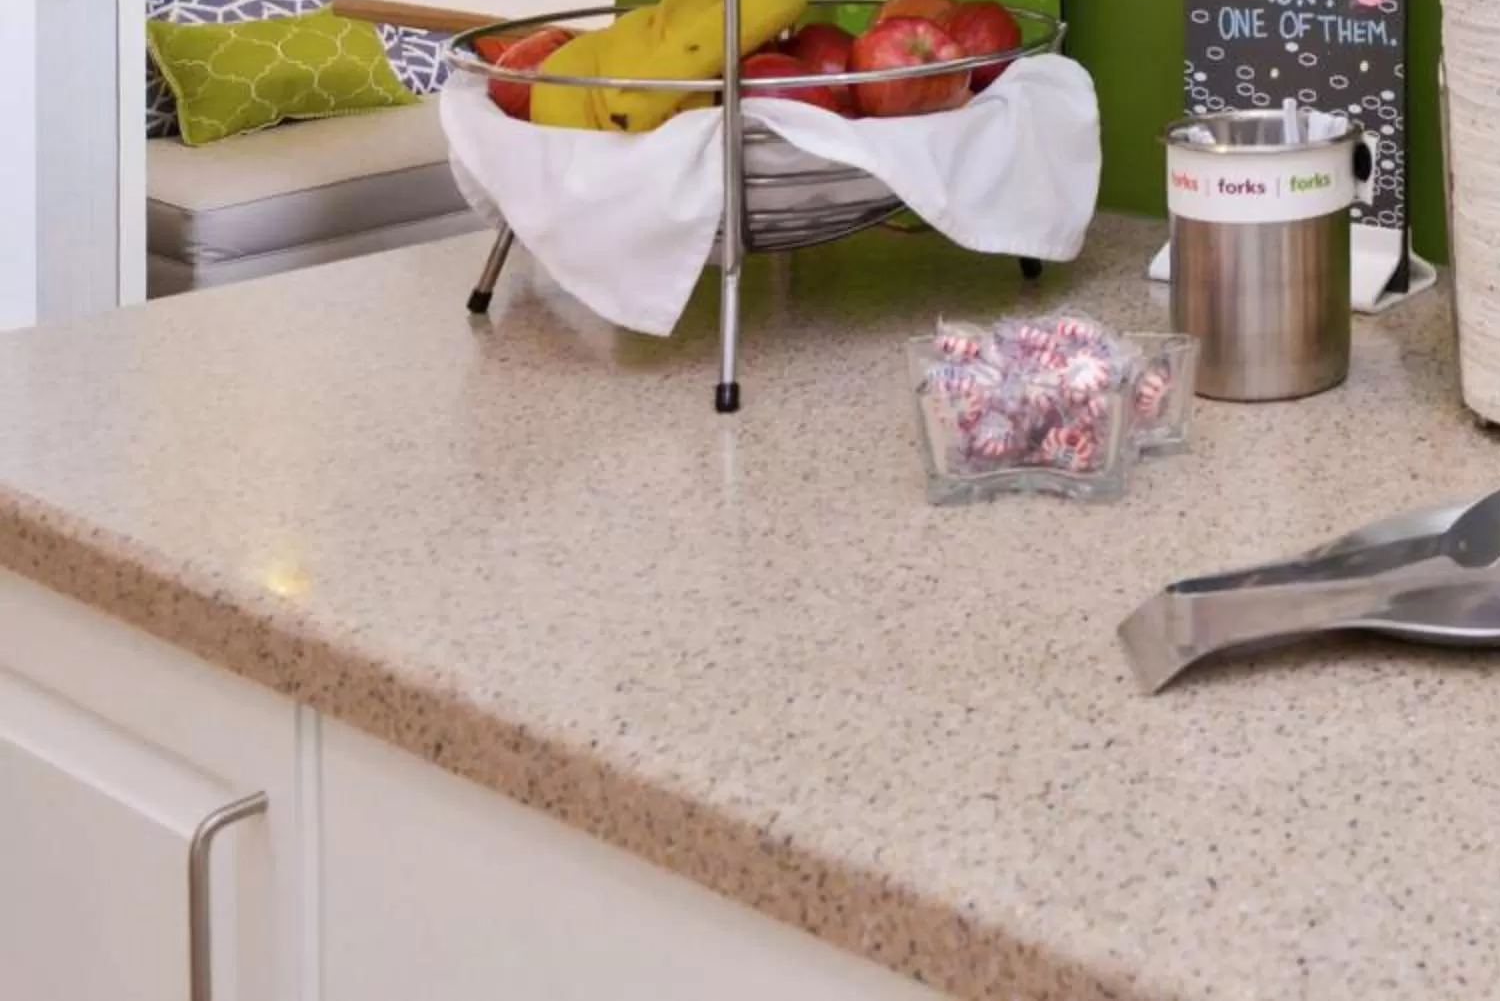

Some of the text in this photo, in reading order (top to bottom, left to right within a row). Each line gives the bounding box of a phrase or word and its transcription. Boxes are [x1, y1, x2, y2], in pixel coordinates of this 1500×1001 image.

[1218, 6, 1398, 47] ONE OF THEM.
[1217, 176, 1267, 195] forks
[1289, 172, 1331, 192] forks
